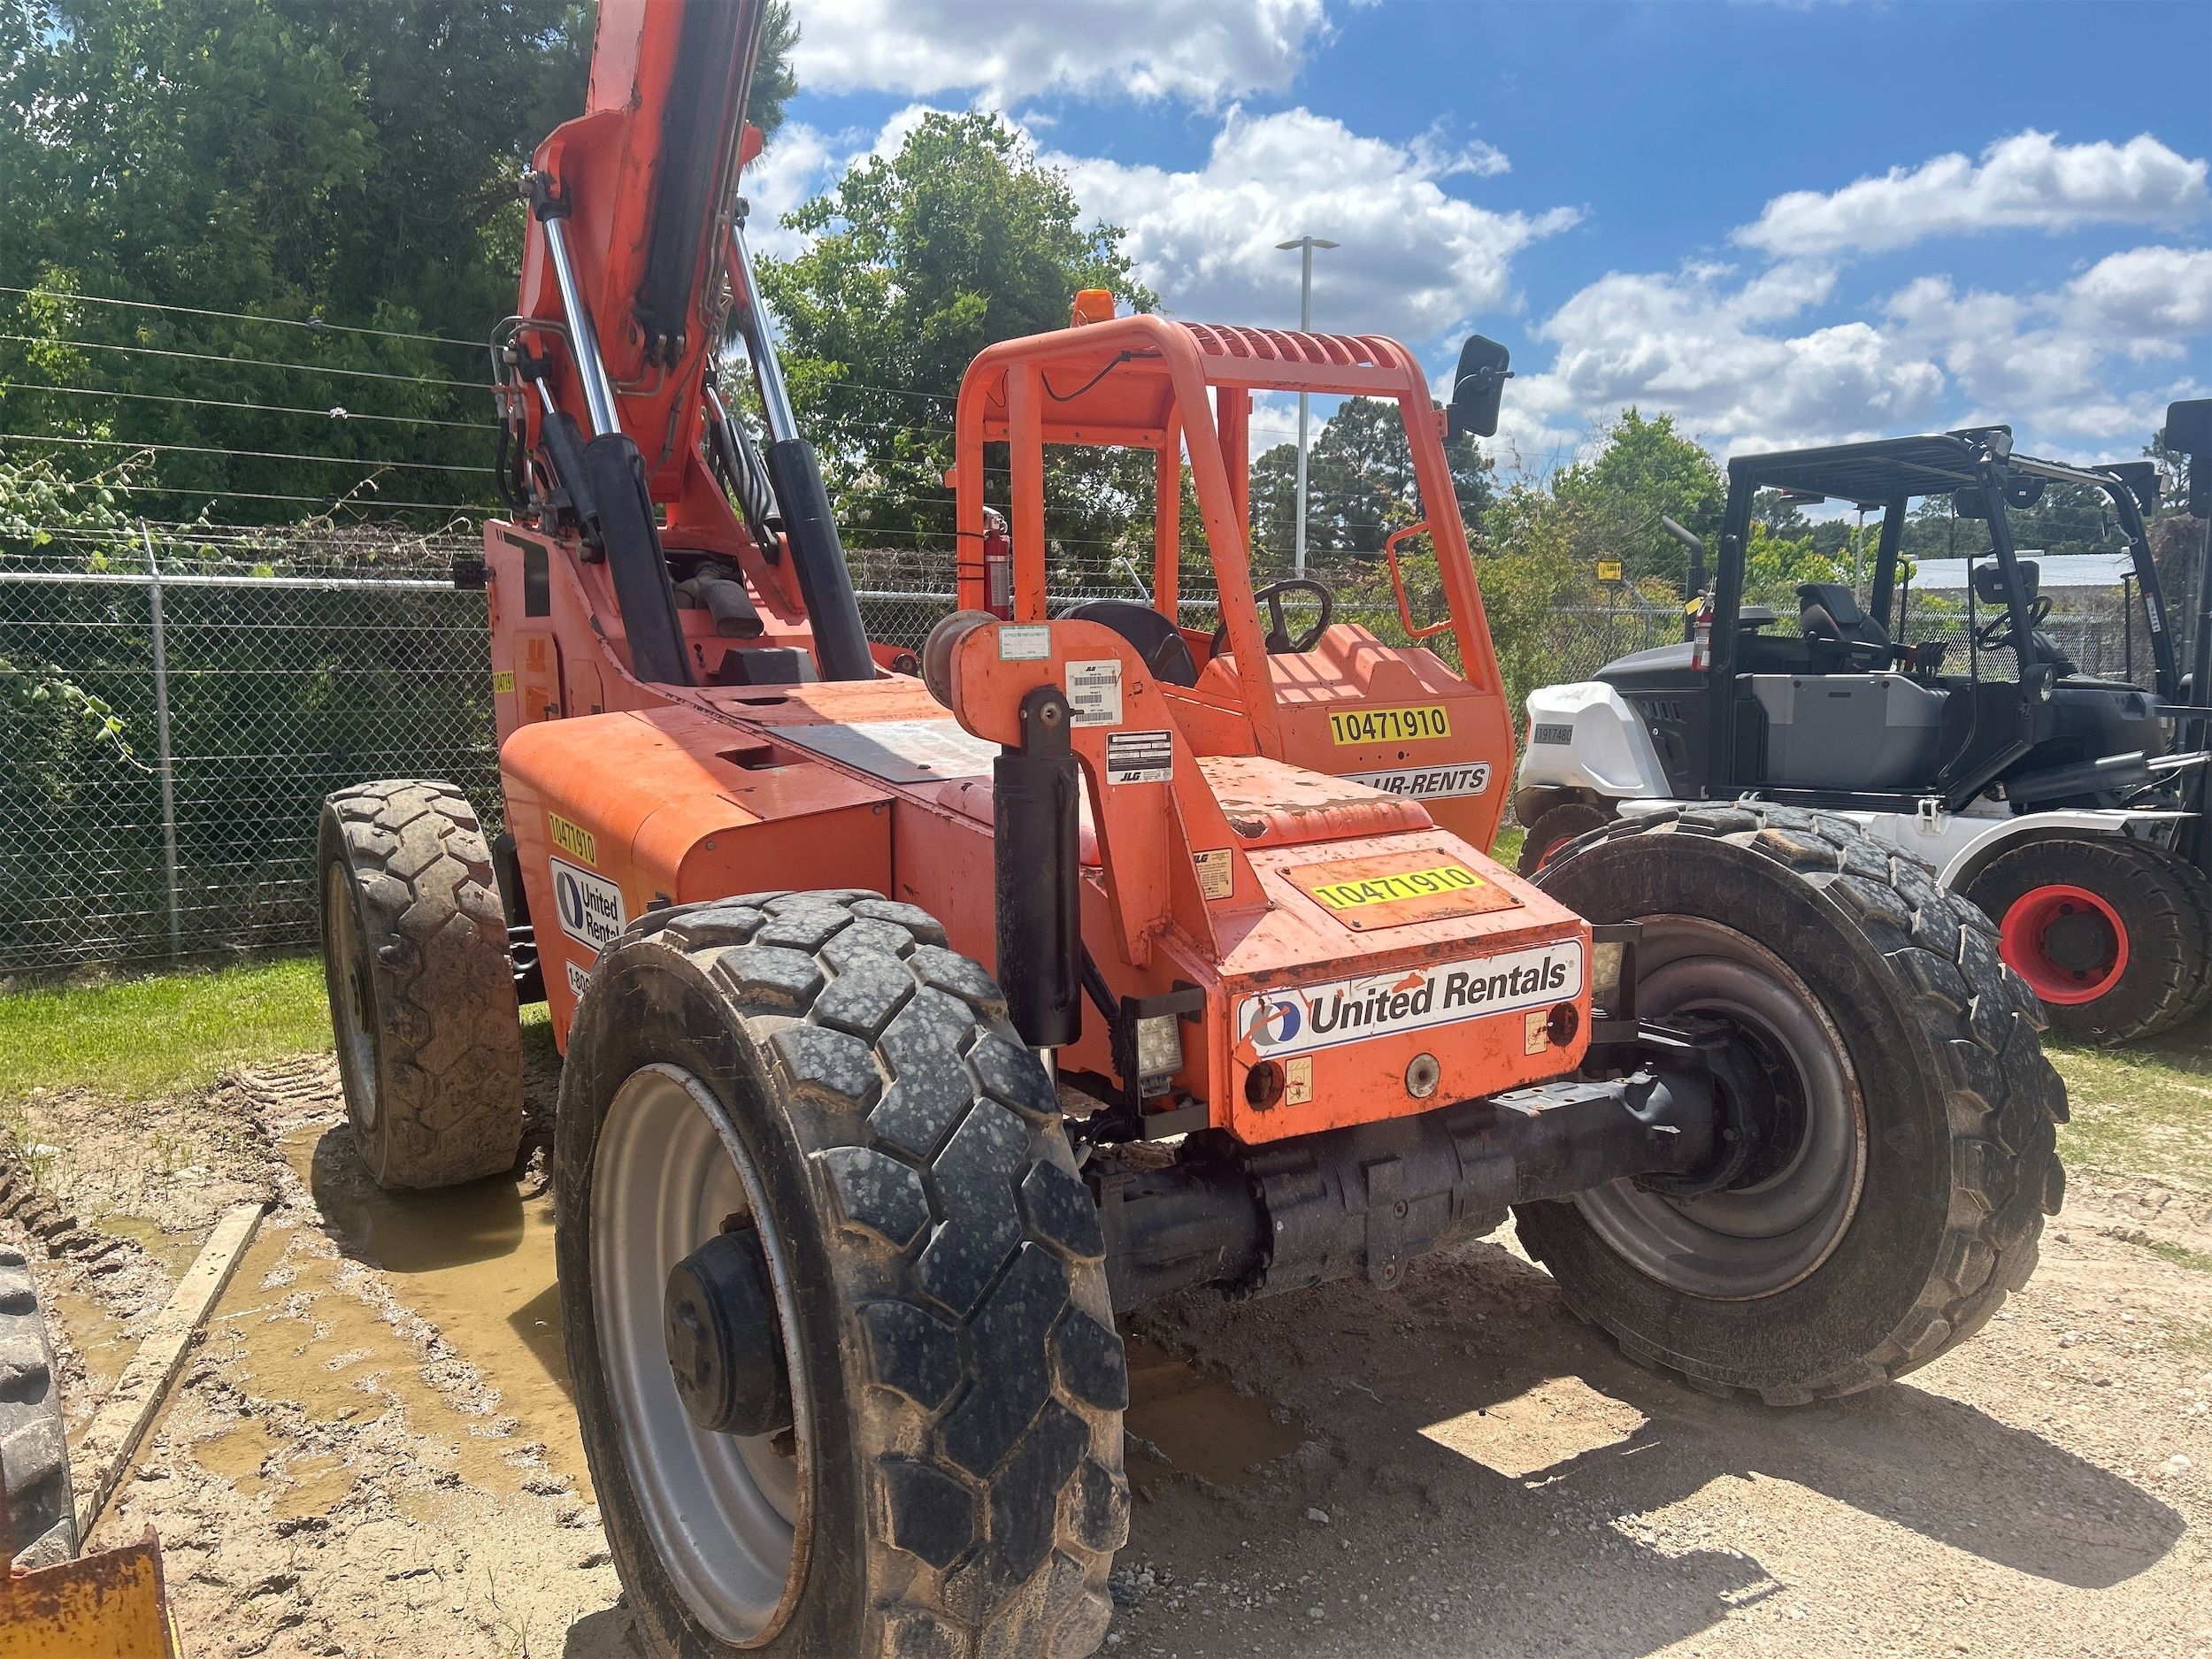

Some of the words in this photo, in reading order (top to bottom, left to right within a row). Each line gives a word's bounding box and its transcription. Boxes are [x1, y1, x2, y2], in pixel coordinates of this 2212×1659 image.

[1332, 709, 1447, 741] 10471910
[1535, 728, 1572, 741] 11917480
[1120, 772, 1141, 782] JLG
[550, 814, 595, 864] 10471910
[580, 880, 618, 922] United
[1316, 868, 1476, 906] 10471910
[1311, 978, 1435, 1034] United
